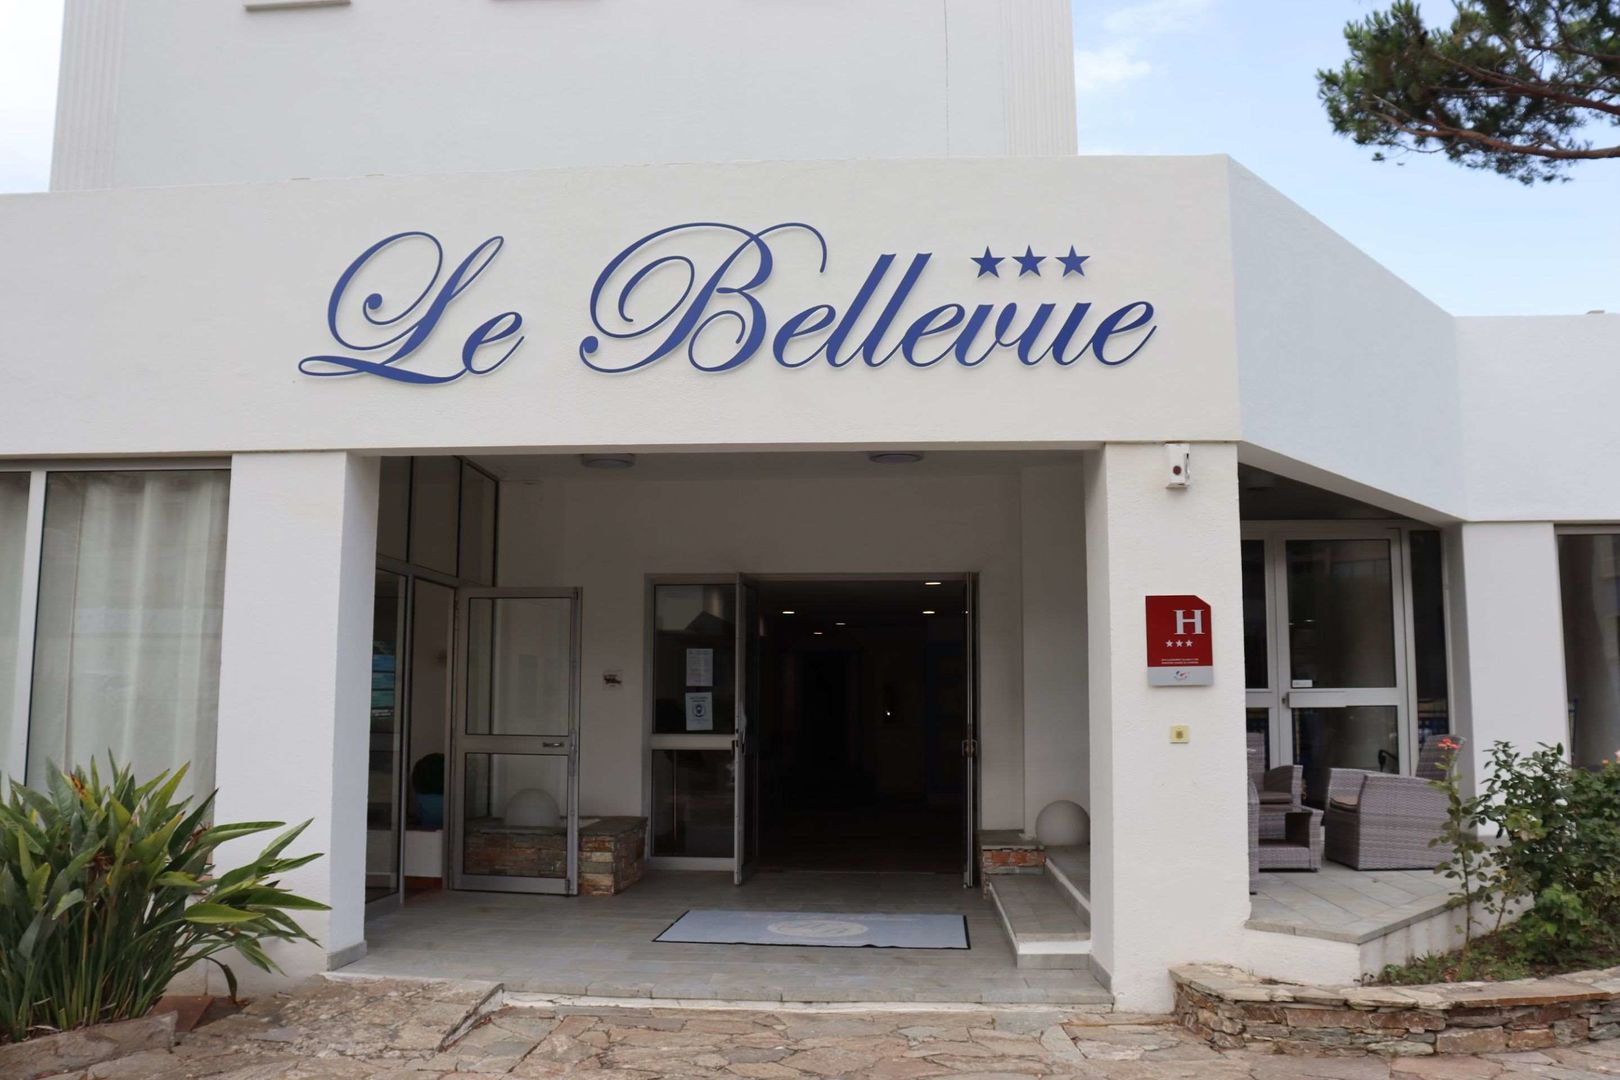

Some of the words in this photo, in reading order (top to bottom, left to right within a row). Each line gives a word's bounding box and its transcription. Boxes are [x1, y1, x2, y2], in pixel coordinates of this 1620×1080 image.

[298, 231, 524, 384] Le
[579, 222, 1158, 373] Bellevue
[1173, 609, 1206, 635] H
